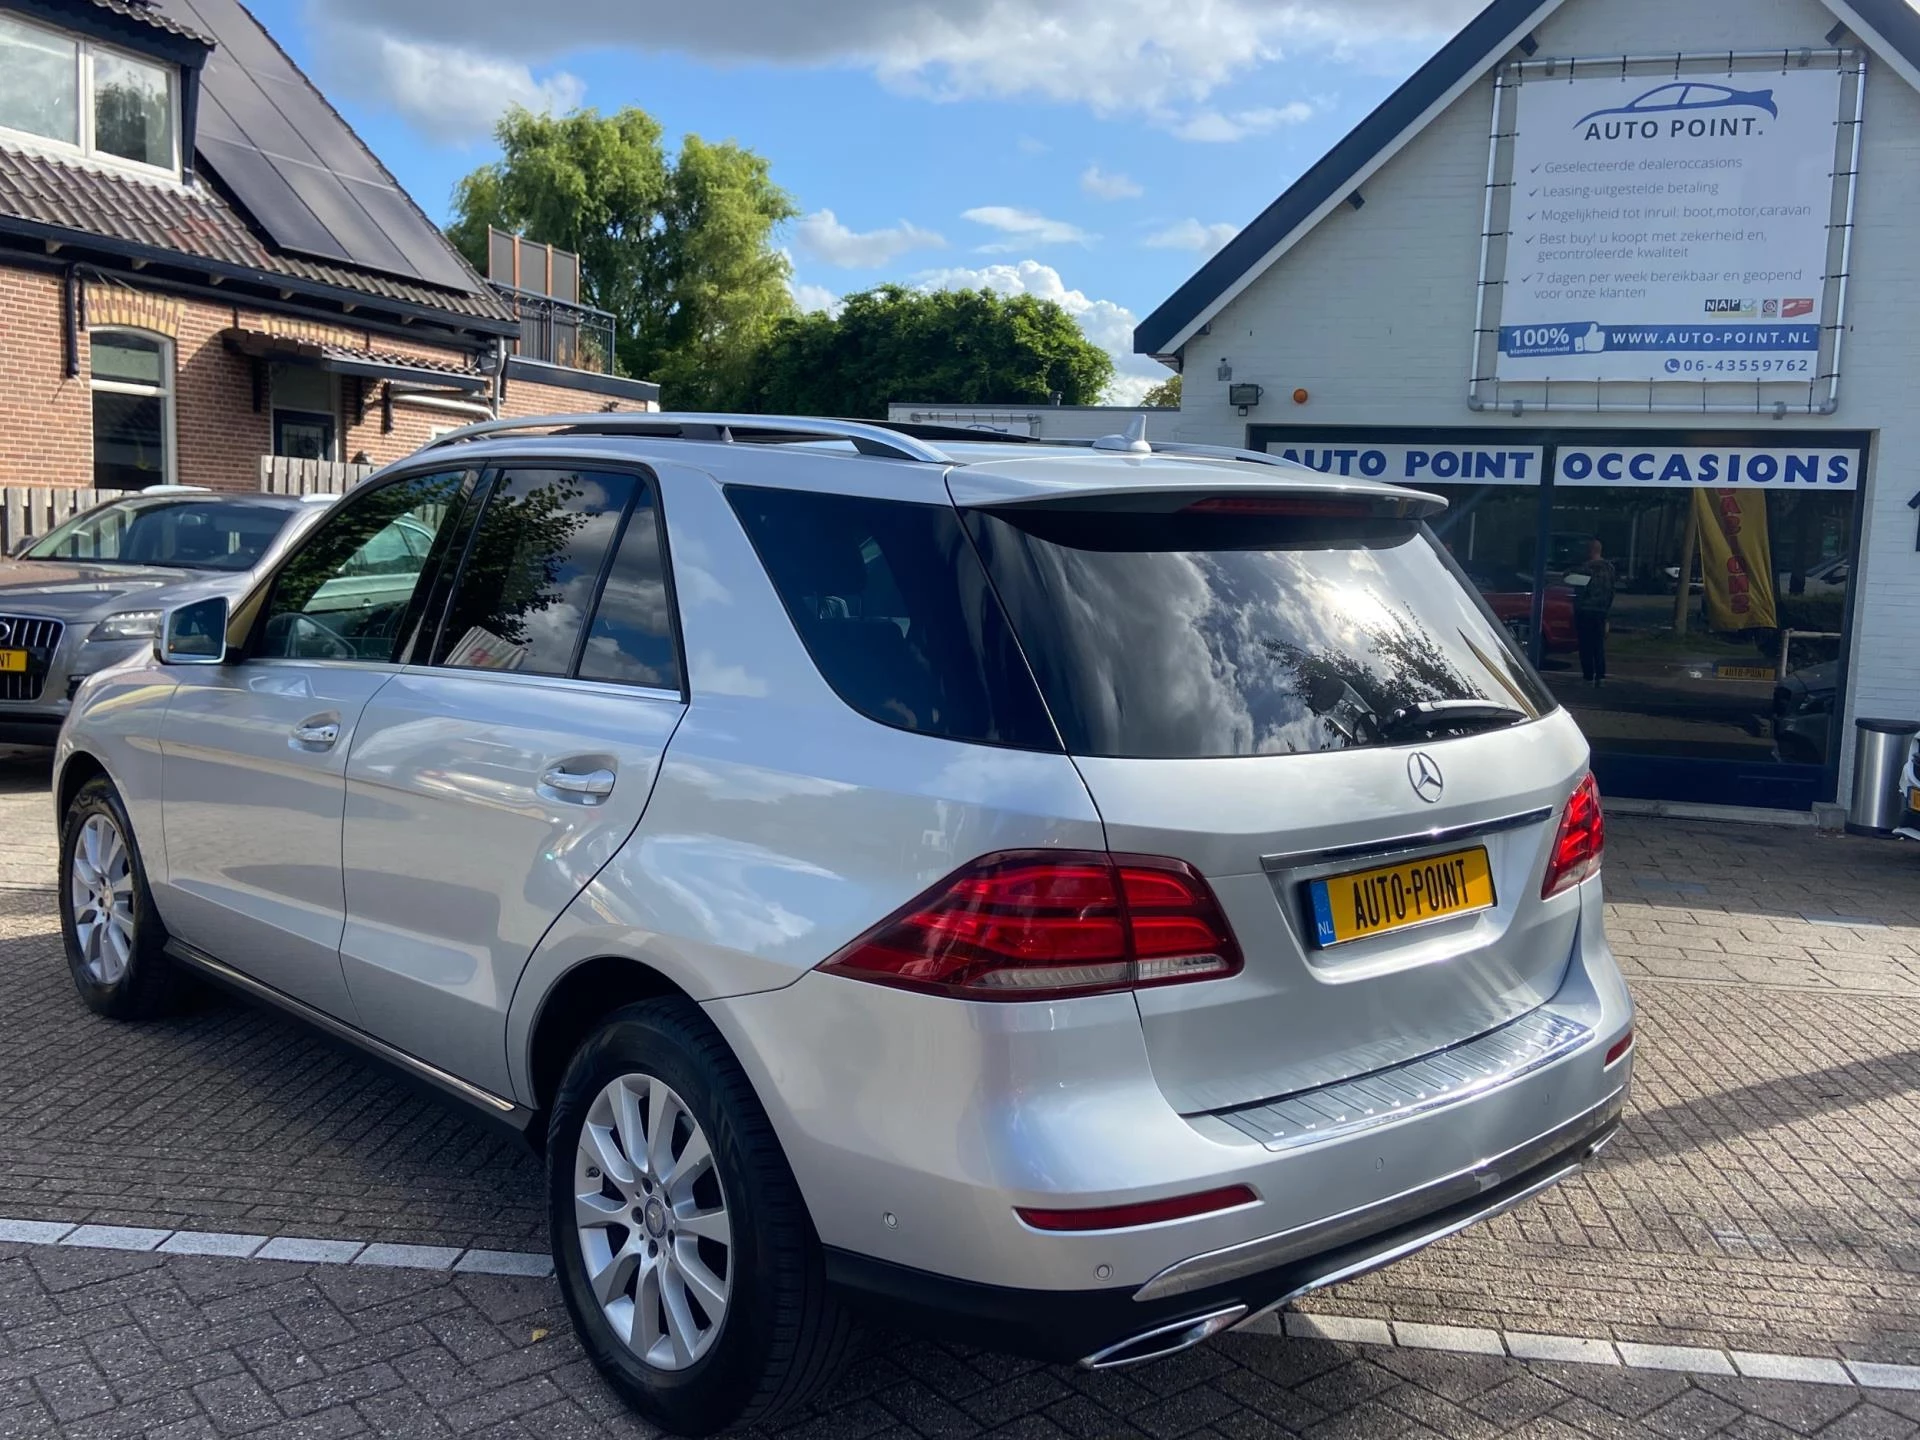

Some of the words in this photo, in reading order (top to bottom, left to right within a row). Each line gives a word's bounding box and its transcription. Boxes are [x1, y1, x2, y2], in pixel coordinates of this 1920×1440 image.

[1584, 120, 1659, 141] AUTO
[1544, 159, 1635, 174] Geselecteerde
[1638, 157, 1743, 170] dealeroccasions
[1667, 181, 1719, 196] betaling
[1541, 208, 1619, 224] Mogelijkheid
[1623, 208, 1641, 219] tot
[1539, 232, 1567, 245] Best
[1570, 231, 1596, 246] buy!
[1600, 234, 1608, 244] u
[1611, 231, 1650, 246] koopt
[1651, 231, 1676, 242] met
[1680, 228, 1743, 242] zekerheid
[1536, 247, 1634, 263] gecontroleerde
[1637, 246, 1689, 258] kwaliteit
[1535, 272, 1545, 283] 7
[1546, 271, 1586, 287] dagen
[1589, 272, 1611, 285] per
[1614, 270, 1647, 283] week
[1650, 269, 1719, 282] bereikbaar
[1723, 271, 1740, 281] en
[1742, 268, 1802, 285] geopend
[1534, 288, 1562, 299] voor
[1565, 287, 1596, 299] onze
[1600, 286, 1646, 299] klanten
[1705, 299, 1741, 312] NAP
[1511, 327, 1570, 347] 100%
[1612, 331, 1811, 345] WWW.AUTO-POINT.NL
[1683, 358, 1809, 372] 06-43559762
[1405, 450, 1535, 479] POINT
[1562, 452, 1849, 483] OCCASIONS
[1353, 859, 1469, 930] AUTO-POINT
[1317, 921, 1334, 937] NL
